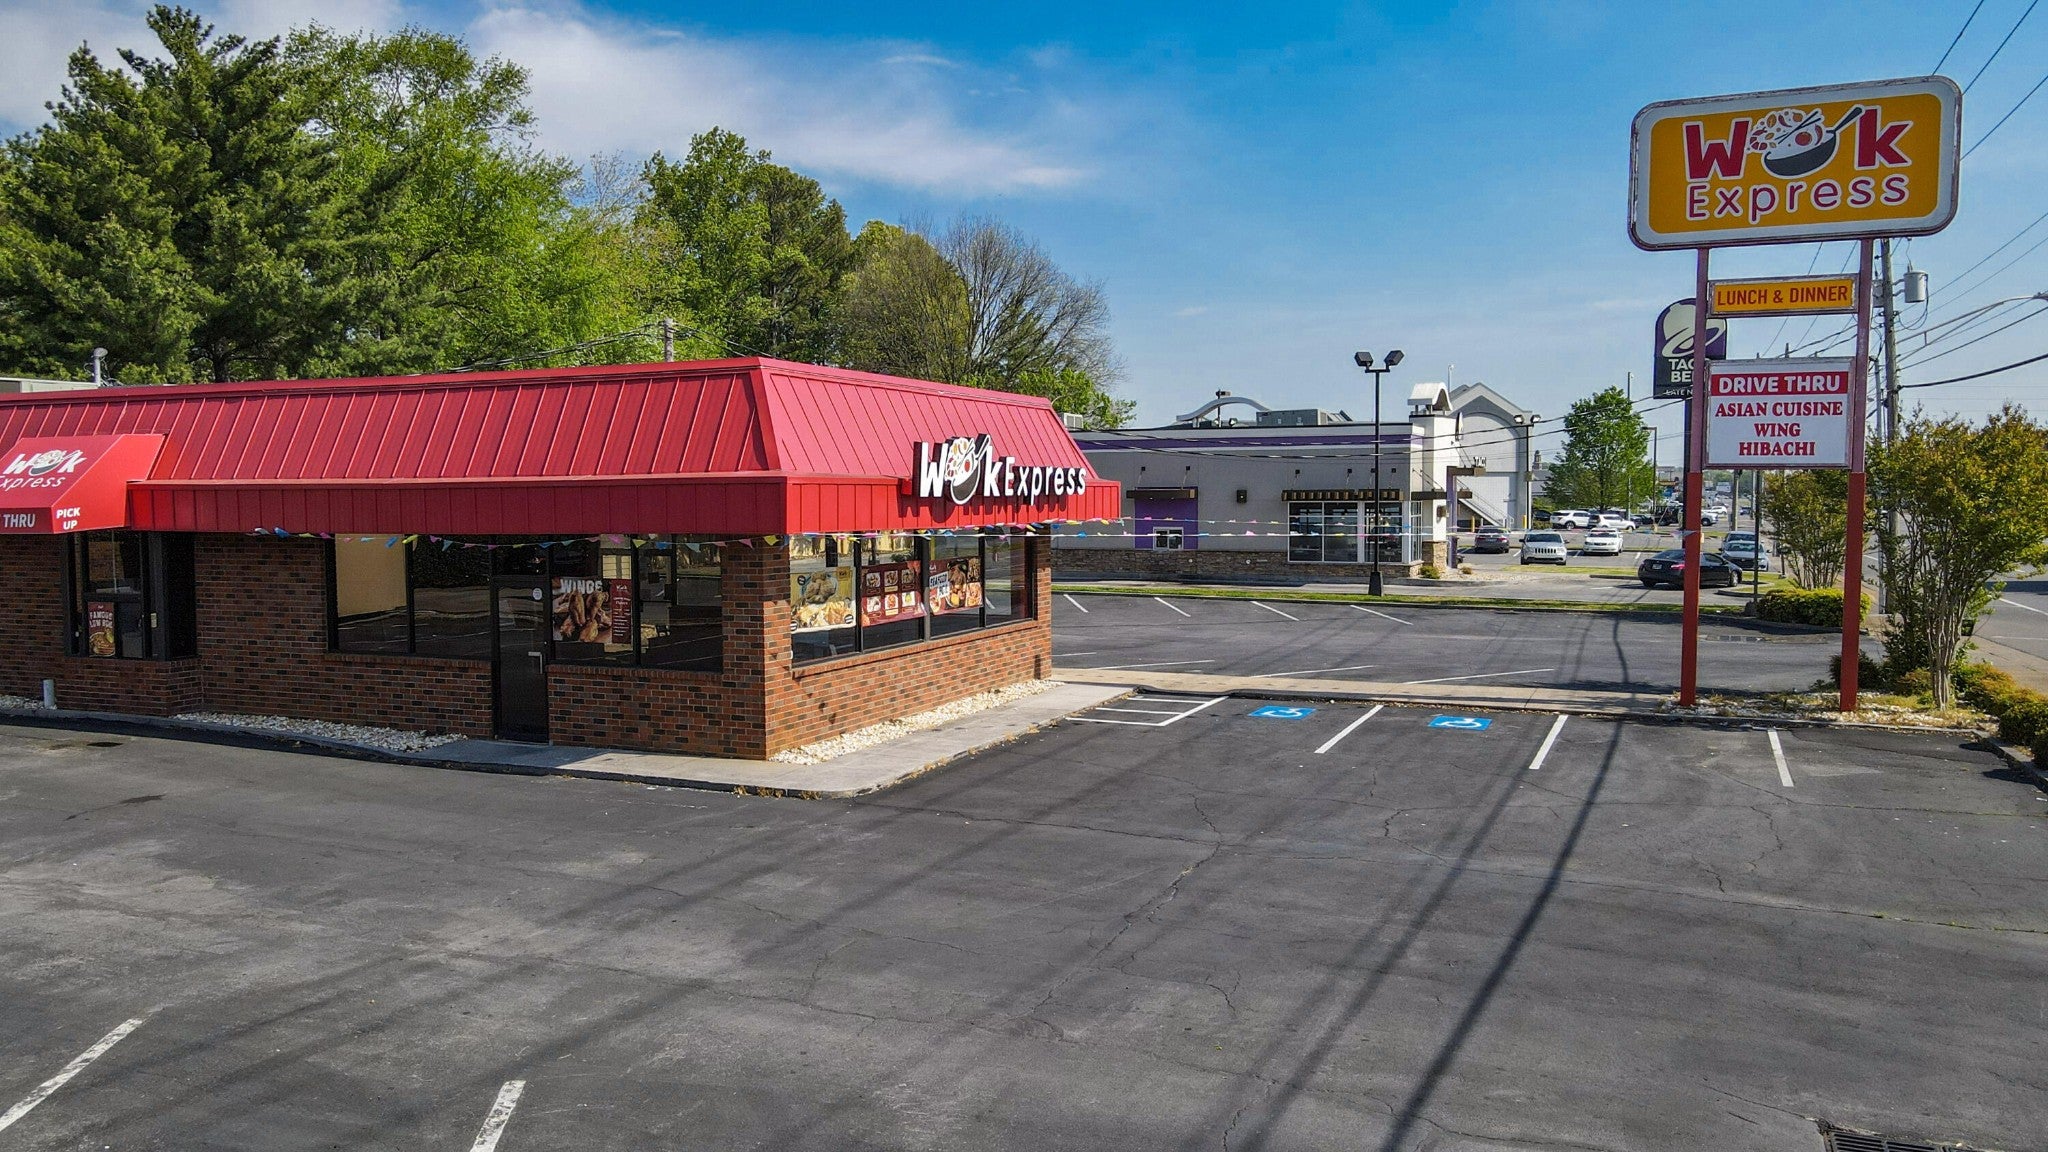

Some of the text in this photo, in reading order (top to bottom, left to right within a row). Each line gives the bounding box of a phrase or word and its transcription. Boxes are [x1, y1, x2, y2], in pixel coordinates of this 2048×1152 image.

[1687, 175, 1909, 222] Express
[1717, 285, 1848, 306] LUNCH & DINNER
[1668, 358, 1709, 371] TAC
[1671, 371, 1706, 383] BE
[1718, 375, 1840, 394] DRIVE THRU
[1715, 401, 1843, 417] ASIAN CUISINE
[1754, 423, 1801, 437] WING
[1739, 441, 1815, 456] HIBACHI
[1004, 457, 1086, 506] Express
[56, 507, 80, 519] PICK
[3, 514, 36, 528] THRU
[63, 520, 78, 530] UP
